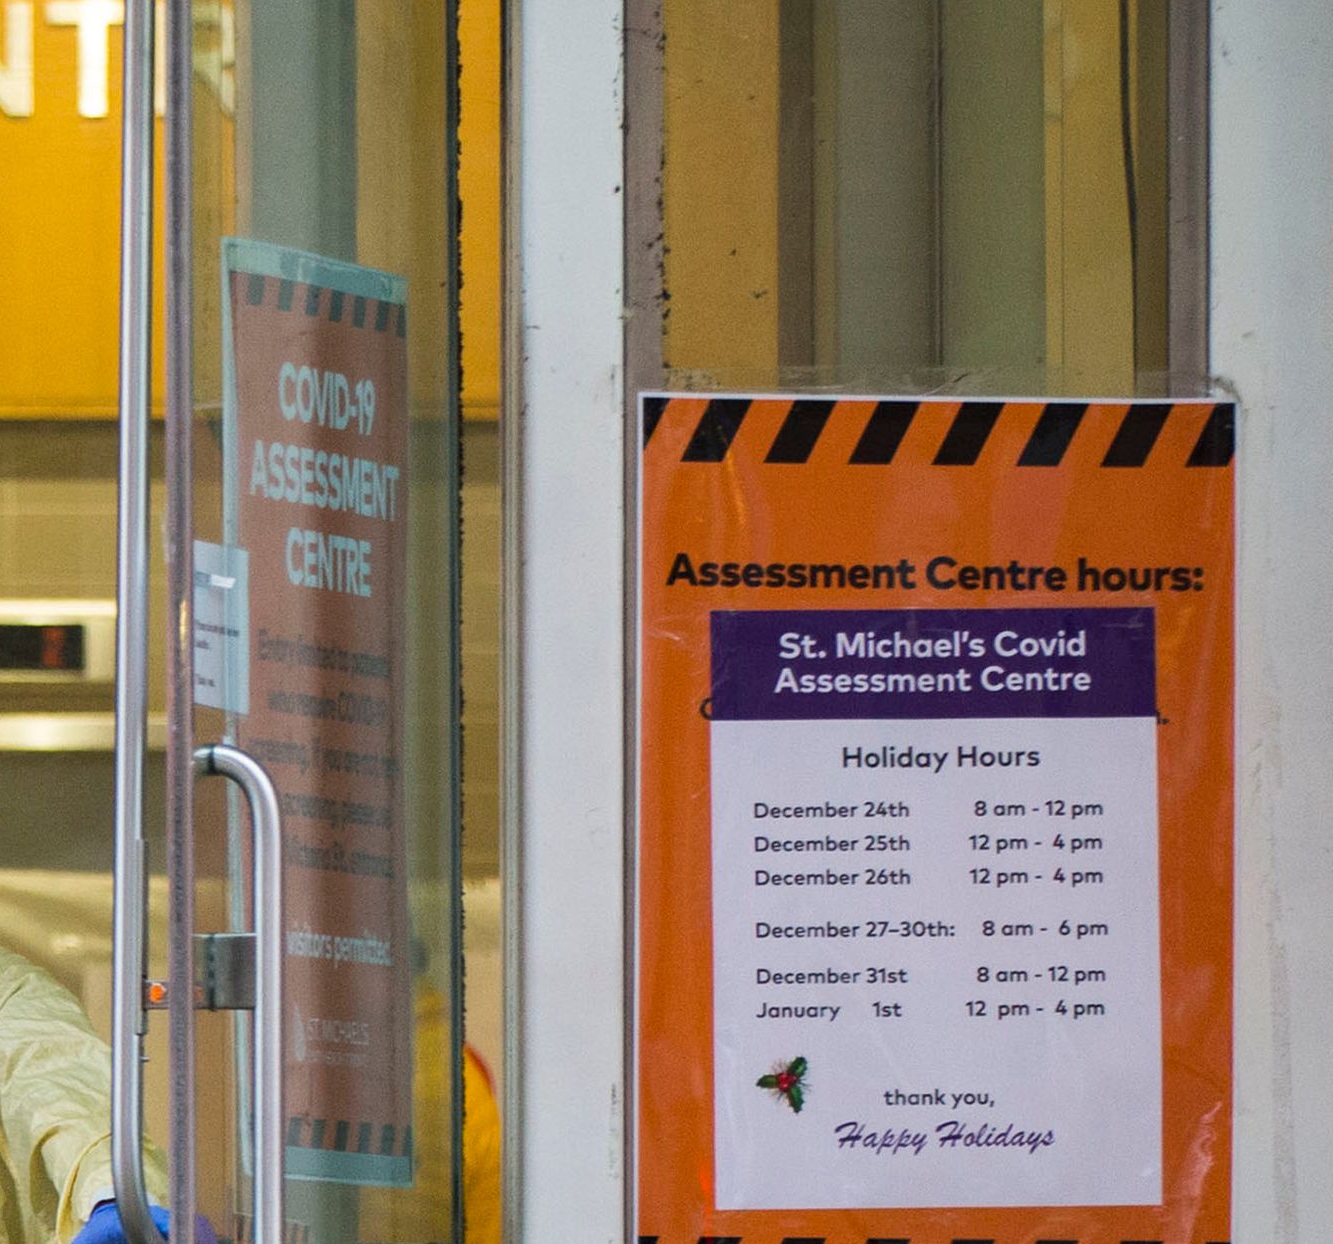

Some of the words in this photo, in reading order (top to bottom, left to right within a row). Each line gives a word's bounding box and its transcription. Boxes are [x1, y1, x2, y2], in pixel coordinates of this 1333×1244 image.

[279, 362, 376, 436] COVID-19
[250, 440, 399, 521] ASSESSMENT
[286, 527, 372, 597] CENTRE
[666, 553, 915, 589] Assessment
[927, 557, 1067, 591] Centre
[1078, 558, 1204, 592] hours:
[780, 633, 826, 658] St.
[836, 631, 985, 658] Michael's
[994, 631, 1085, 657] Covid
[775, 668, 971, 693] Assessment
[981, 666, 1091, 691] Centre
[843, 746, 948, 774] Holiday
[958, 746, 1040, 767] Hours
[754, 802, 858, 818] December
[864, 802, 909, 817] 24th
[974, 800, 987, 816] 8
[993, 805, 1025, 816] am
[1045, 800, 1065, 816] 12
[1072, 804, 1103, 819] pm
[755, 836, 858, 852] December
[865, 835, 910, 851] 25th
[969, 834, 989, 850] 12
[996, 838, 1028, 854] pm
[1053, 834, 1065, 849] 4
[1071, 838, 1102, 853] pm
[755, 869, 859, 886] December
[865, 869, 910, 885] 26th
[970, 868, 990, 884] 12
[997, 872, 1028, 887] pm
[1053, 868, 1065, 883] 4
[1072, 872, 1103, 887] pm
[756, 922, 860, 938] December
[982, 920, 995, 936] 8
[1001, 924, 1033, 936] am
[1059, 920, 1071, 936] 6
[1077, 924, 1108, 939] pm
[757, 968, 860, 984] December
[867, 967, 907, 984] 31st
[977, 967, 989, 983] 8
[996, 971, 1028, 982] am
[1048, 966, 1068, 982] 12
[1075, 970, 1105, 985] pm
[756, 1003, 840, 1021] January
[872, 1002, 902, 1017] 1st
[966, 1000, 986, 1016] 12
[998, 1004, 1029, 1020] pm
[1055, 1000, 1067, 1015] 4
[1074, 1004, 1105, 1019] pm
[884, 1089, 945, 1106] thank
[952, 1093, 994, 1110] you,
[835, 1122, 927, 1155] Happy
[935, 1121, 1053, 1154] Holidays
